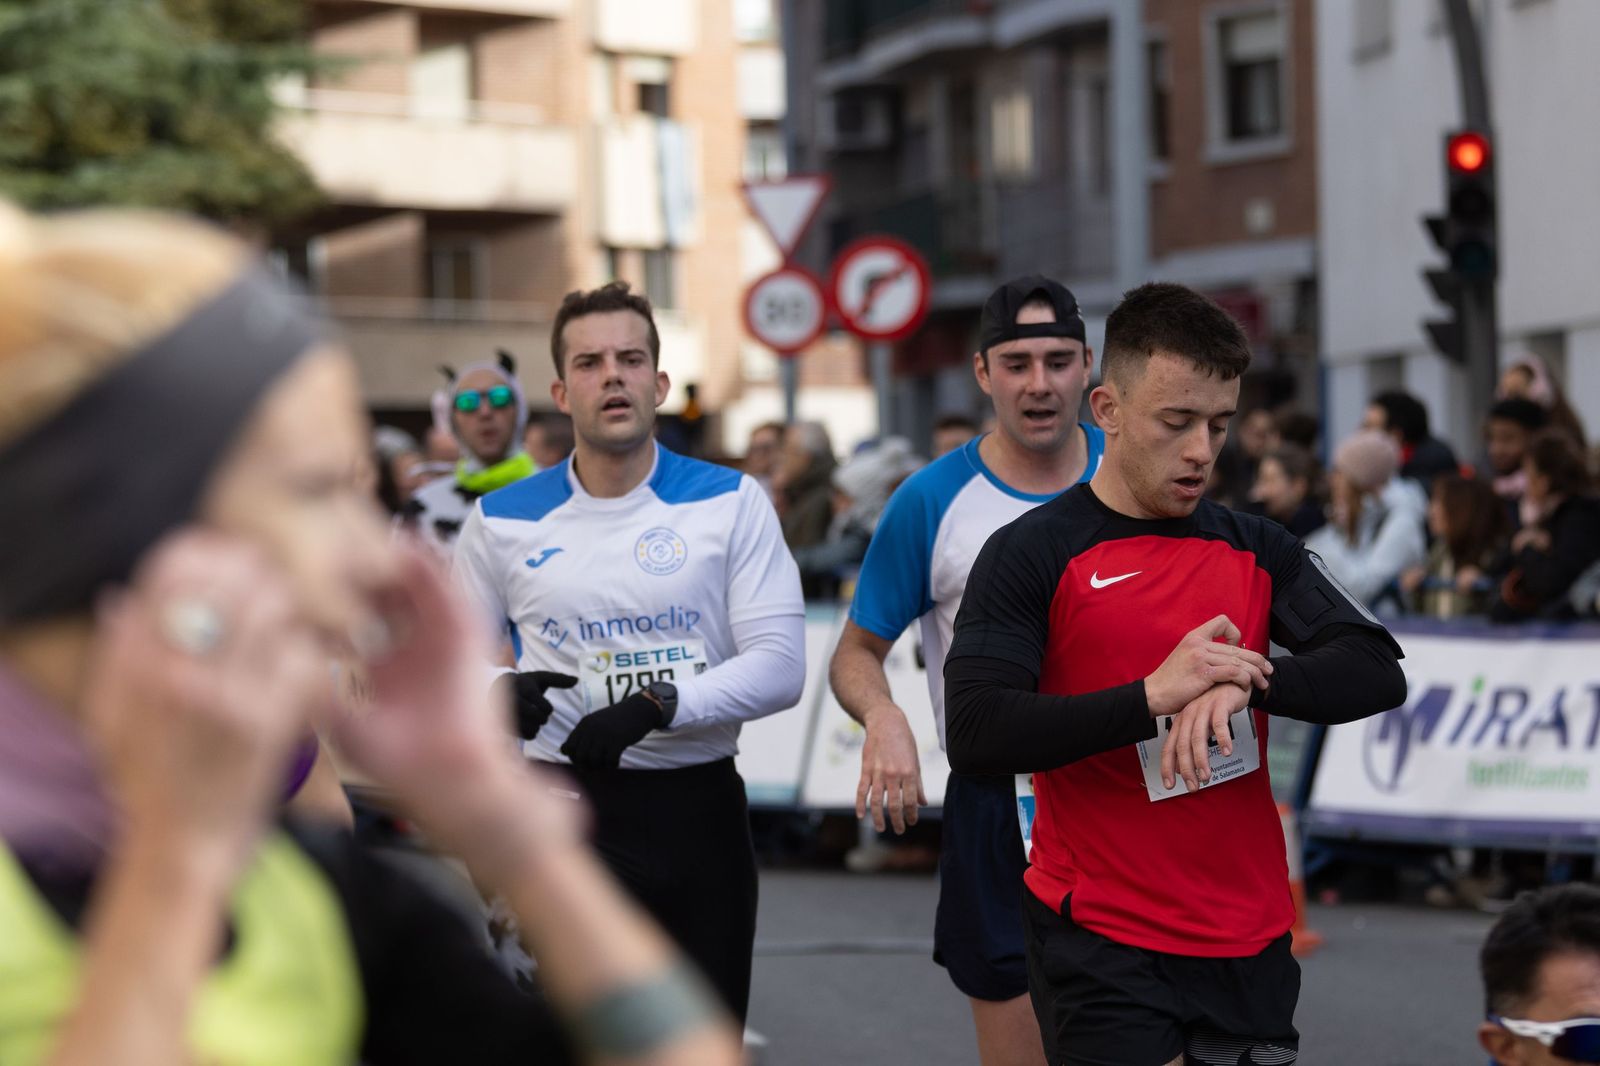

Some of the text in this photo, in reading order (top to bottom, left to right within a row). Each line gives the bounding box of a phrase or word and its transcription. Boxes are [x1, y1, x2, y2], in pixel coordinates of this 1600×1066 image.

[578, 606, 701, 642] inmoclip
[615, 646, 694, 668] SETEL
[1210, 757, 1244, 774] Ayuntamiento
[1212, 766, 1246, 782] de Salamanca
